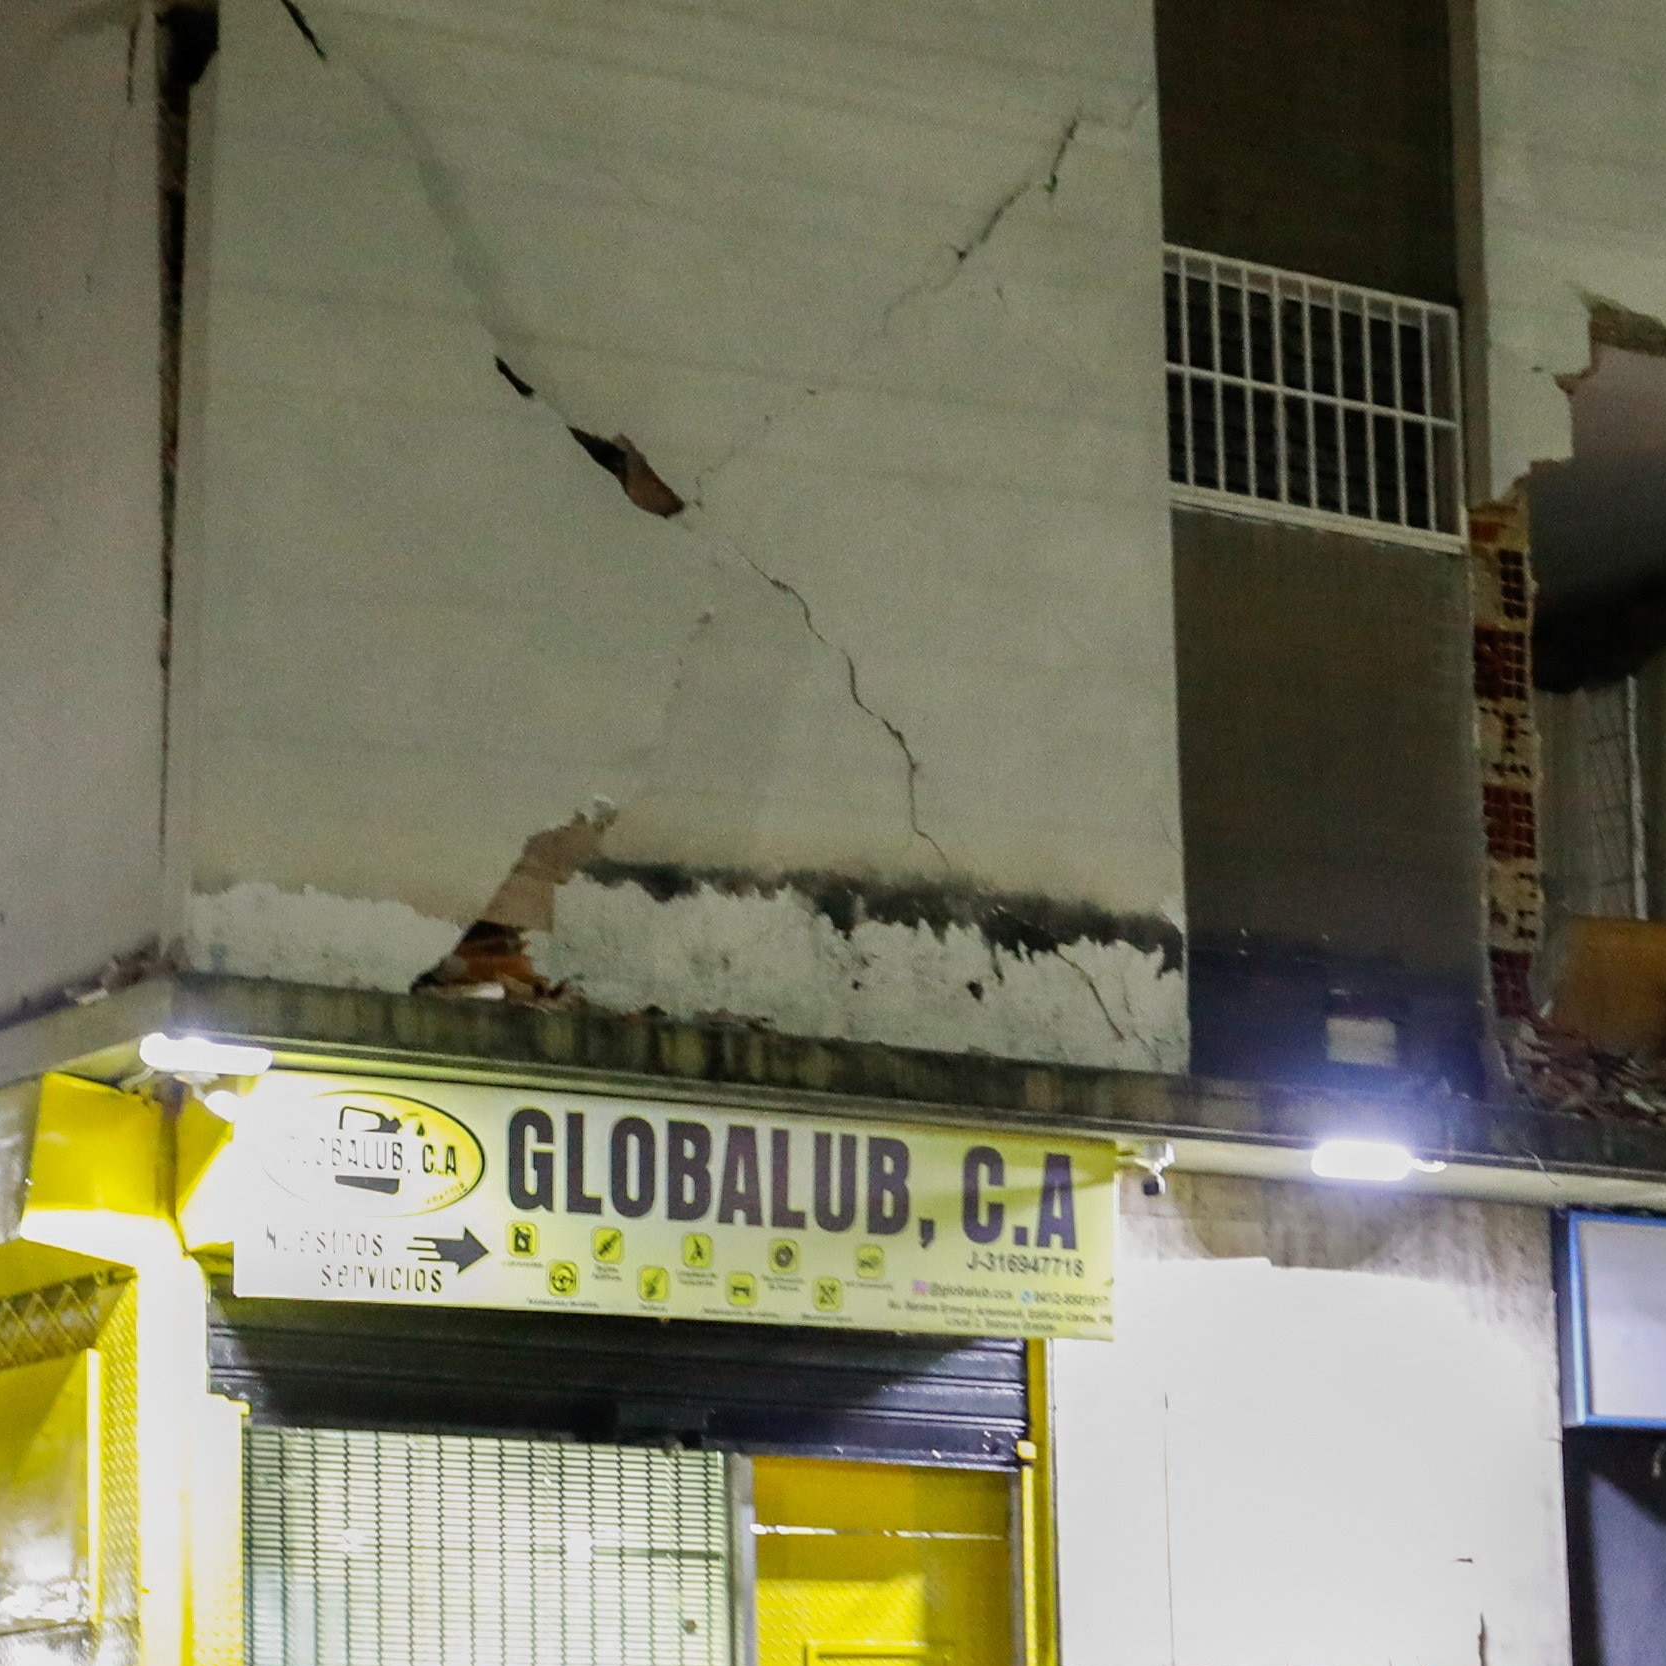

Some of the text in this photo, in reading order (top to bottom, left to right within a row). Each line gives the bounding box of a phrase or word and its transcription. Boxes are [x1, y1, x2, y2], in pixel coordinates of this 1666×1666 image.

[506, 1106, 1079, 1251] GLOBALUB, C.A
[265, 1224, 385, 1258] Nestros
